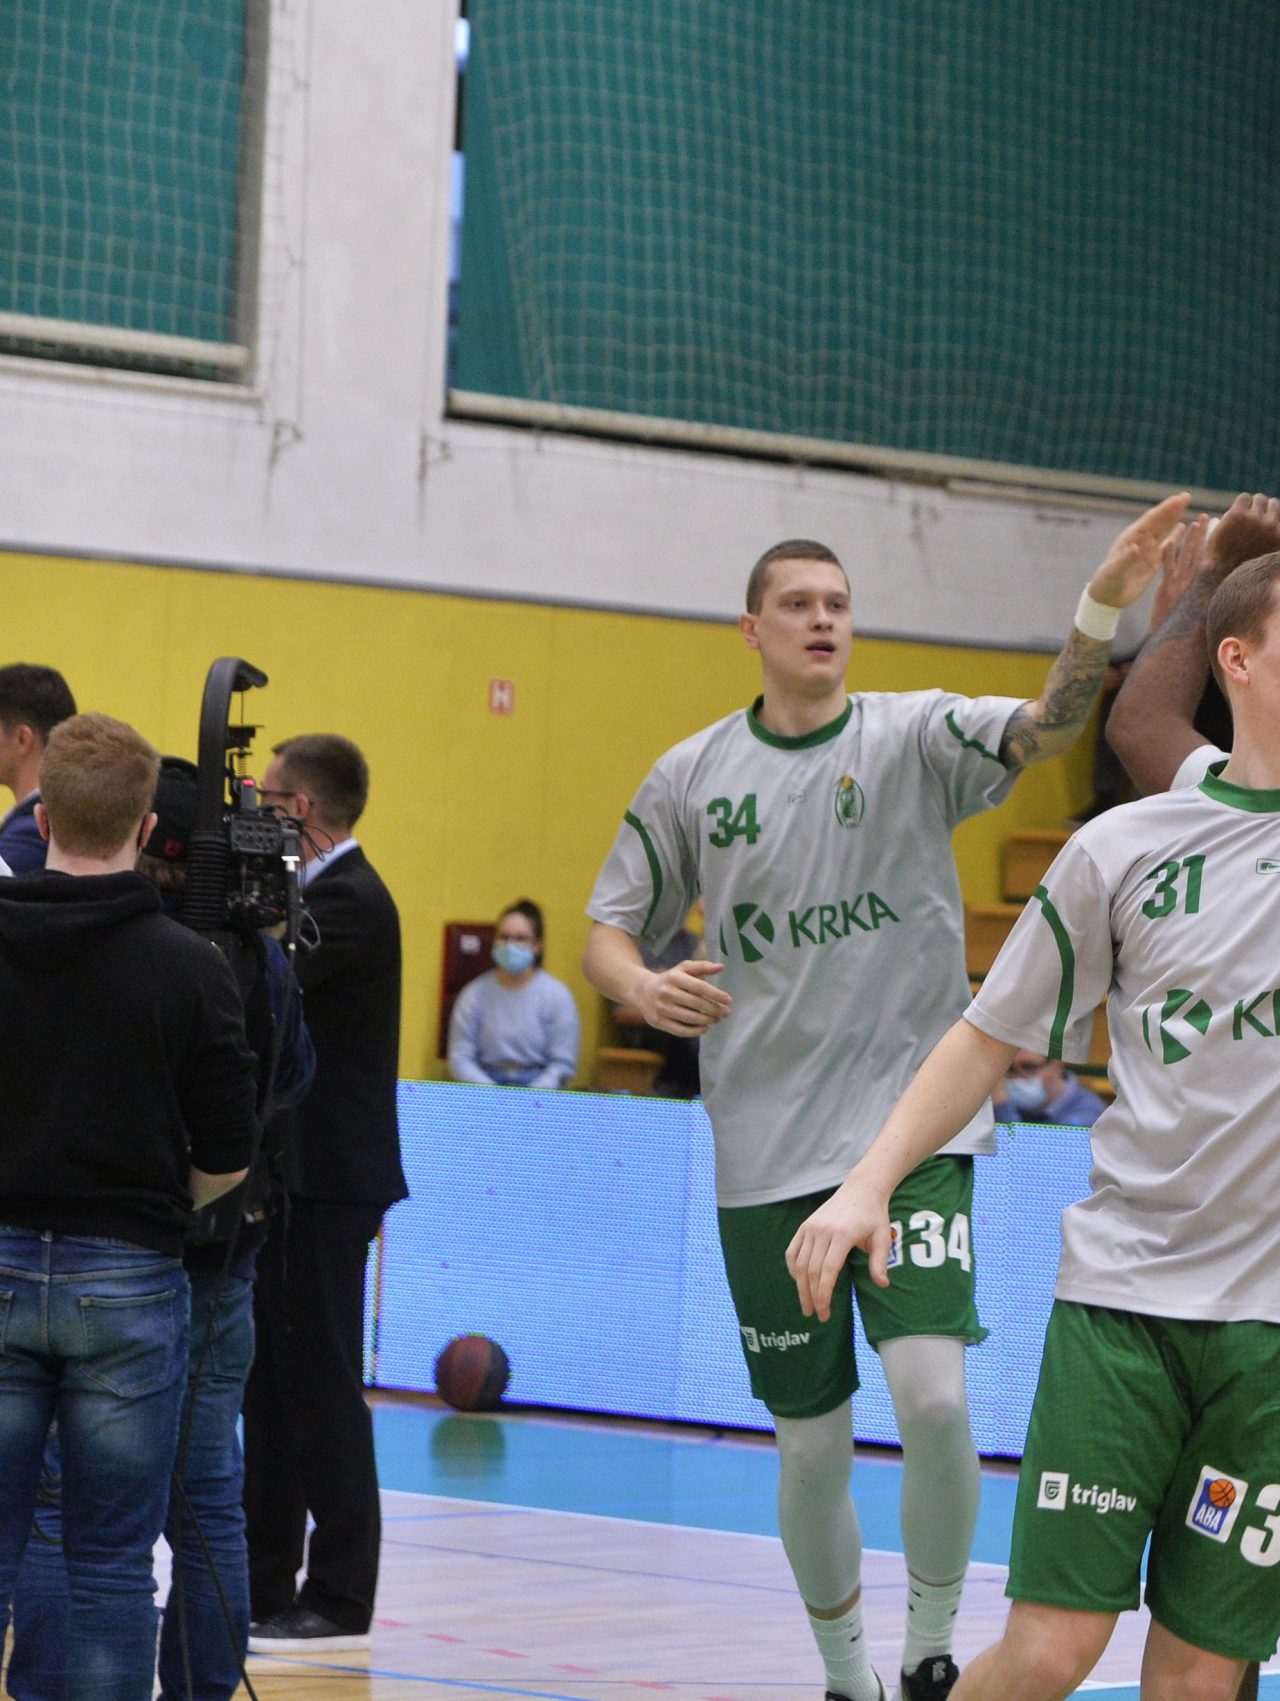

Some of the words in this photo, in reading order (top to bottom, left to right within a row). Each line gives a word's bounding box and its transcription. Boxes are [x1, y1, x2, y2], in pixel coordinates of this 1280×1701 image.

[706, 793, 762, 849] 34
[1142, 854, 1207, 920] 31
[787, 890, 901, 949] KRKA
[908, 1209, 972, 1273] 34
[759, 1330, 811, 1352] triglav
[1071, 1484, 1137, 1514] triglav
[1194, 1504, 1223, 1532] ABA
